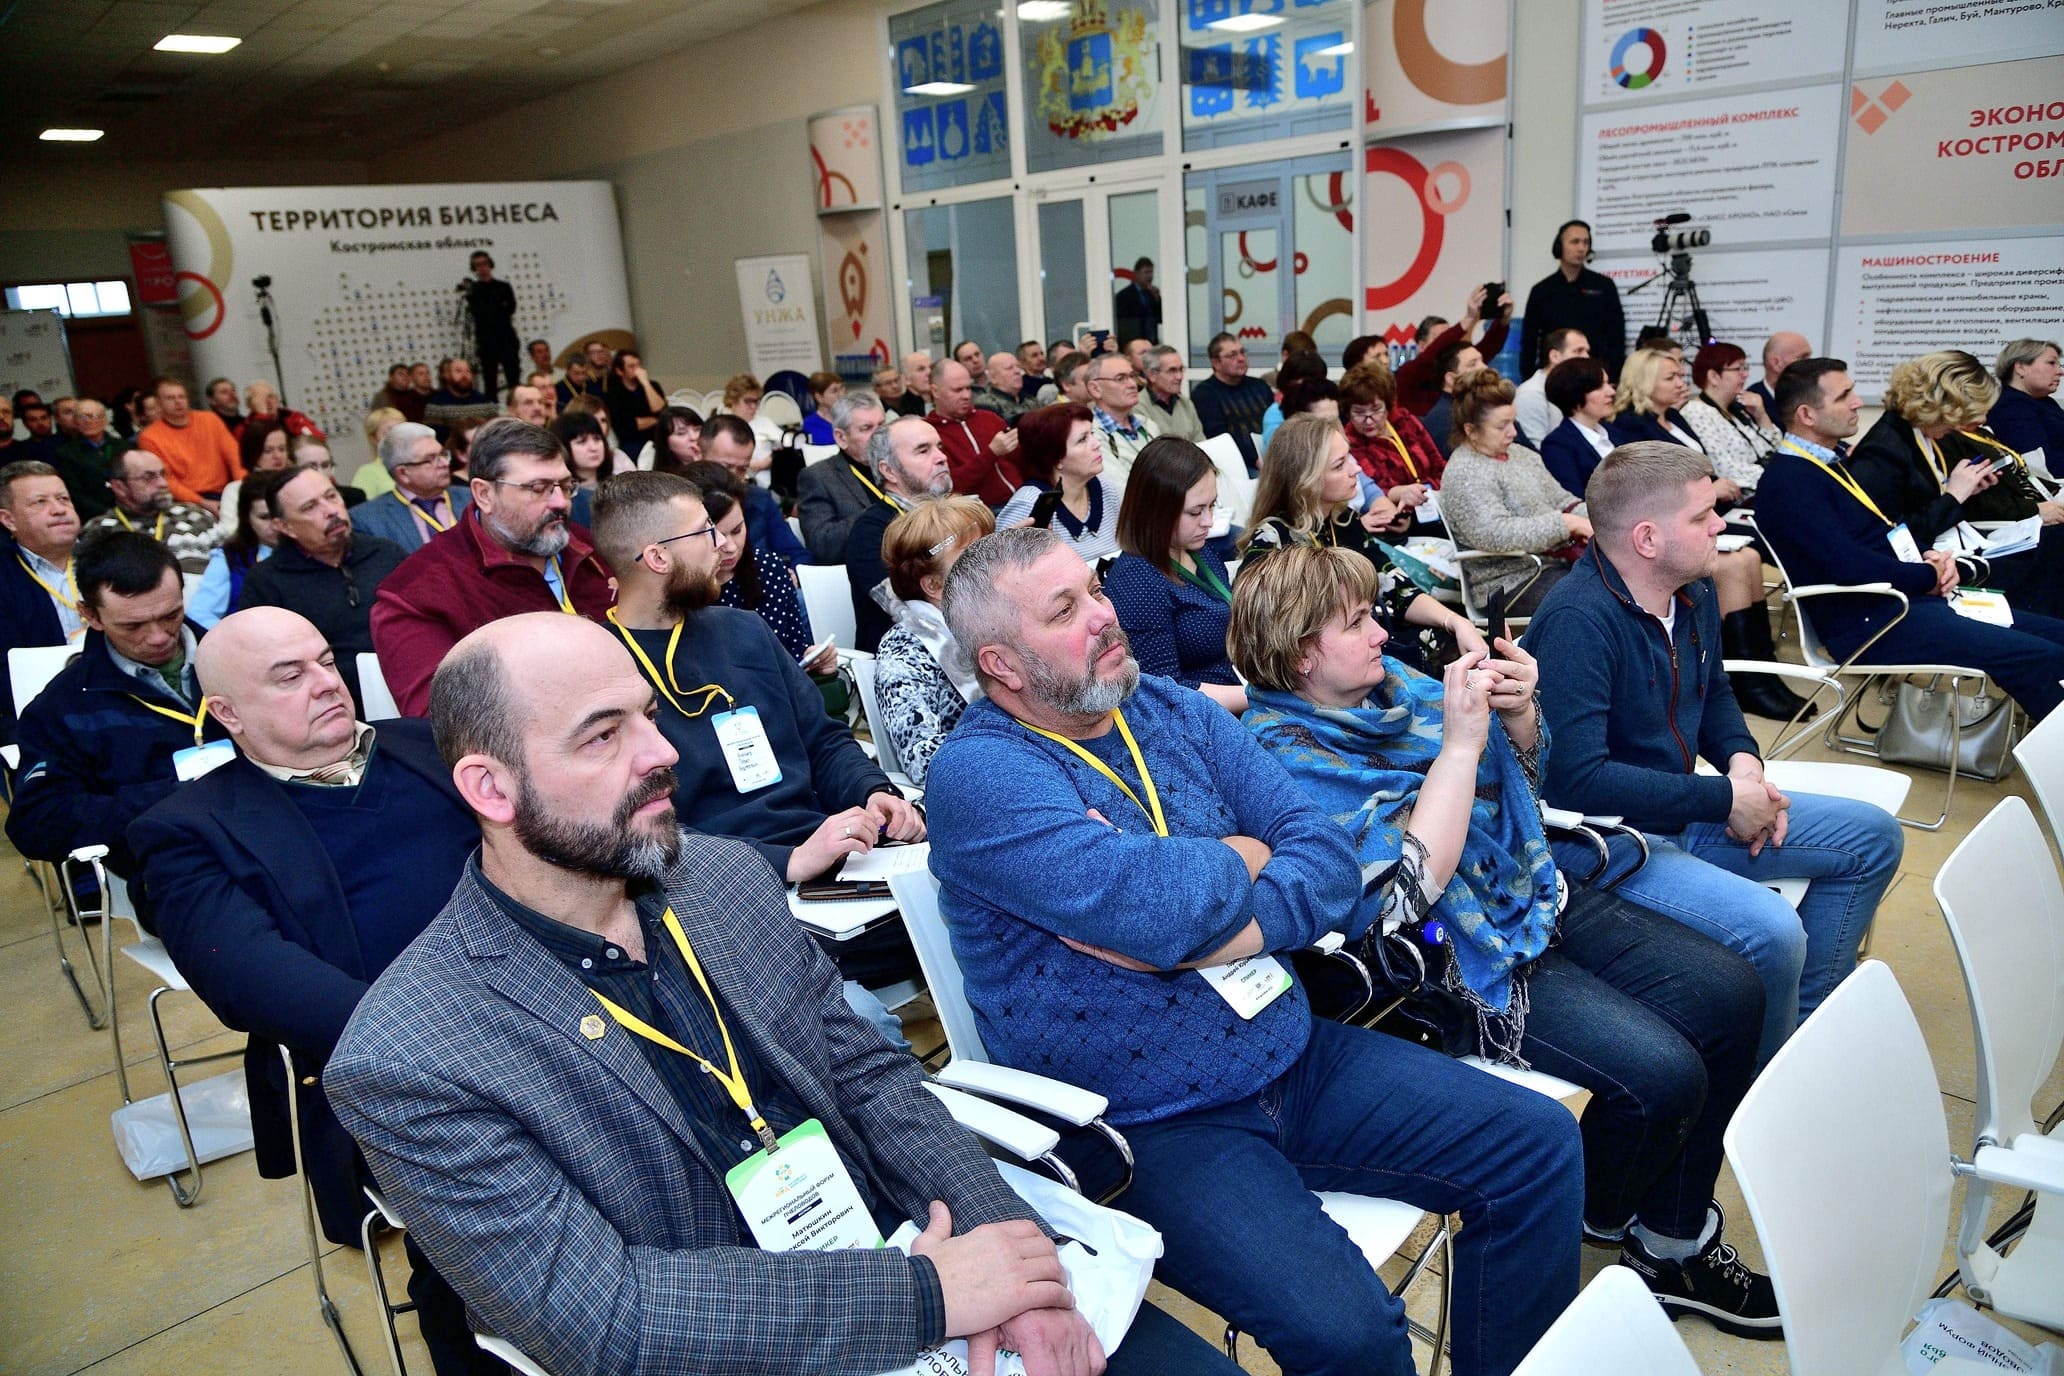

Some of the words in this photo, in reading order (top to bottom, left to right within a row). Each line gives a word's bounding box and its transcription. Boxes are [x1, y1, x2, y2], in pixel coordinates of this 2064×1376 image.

[1929, 15, 1958, 24] Галич,
[1960, 10, 1982, 21] Буй,
[1983, 3, 2045, 16] Мантурово,
[1598, 115, 1730, 139] ЛЕСОПРОМЫШЛЕННЫЙ
[1731, 106, 1800, 123] КОМПЛЕКС
[1969, 101, 2064, 128] ЭКОНО
[1937, 131, 2064, 158] КОСТРОМ
[1236, 192, 1277, 210] КАФЕ
[250, 207, 433, 232] ТЕРРИТОРИЯ
[438, 202, 559, 227] БИЗНЕСА
[329, 238, 432, 254] Костромская
[435, 236, 494, 250] область
[1861, 252, 2000, 268] МАШИНОСТРОЕНИЕ
[1970, 278, 2032, 288] Предприятия
[2018, 293, 2050, 301] краны,
[753, 308, 806, 325] УНЖА
[761, 1184, 817, 1225] МЕЖРЕГИОНАЛЬНЫЙ
[816, 1172, 835, 1188] ФОРУМ
[783, 1191, 820, 1218] ПЧЕЛОВОДОВ
[791, 1208, 833, 1239] Матюшкин
[811, 1204, 854, 1238] Викторович
[1938, 1321, 1976, 1349] ФОРУМ
